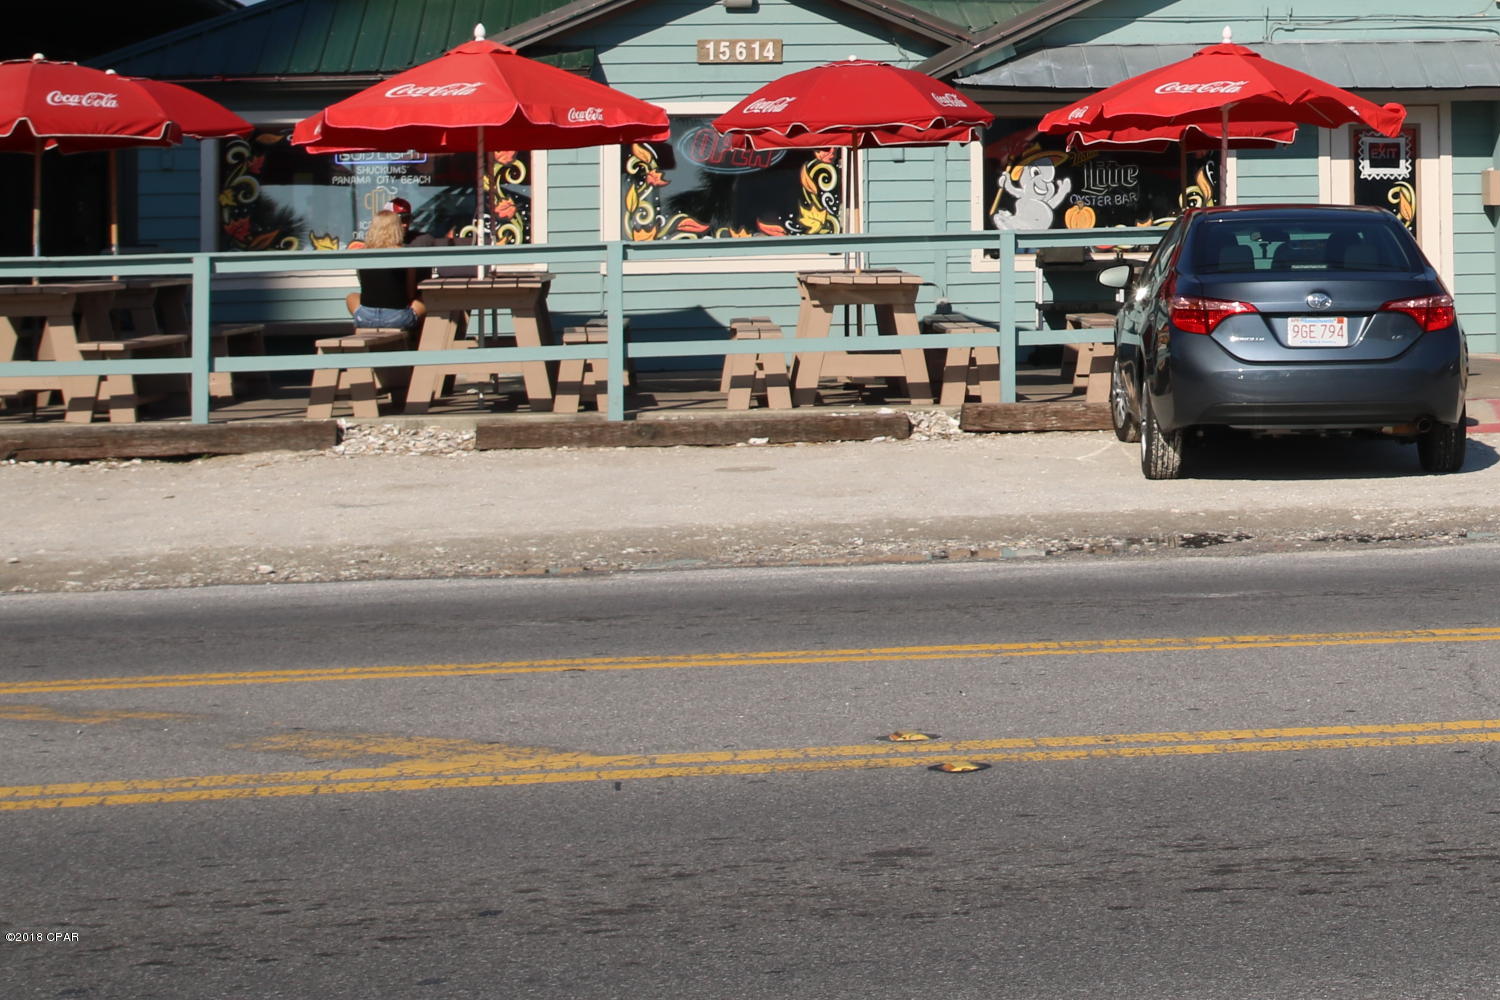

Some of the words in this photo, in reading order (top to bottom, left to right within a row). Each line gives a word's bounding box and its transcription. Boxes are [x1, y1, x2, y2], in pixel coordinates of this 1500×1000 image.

[705, 40, 776, 61] 15614
[384, 81, 486, 98] Coca-Cola
[1155, 80, 1249, 95] Coca-Cola
[46, 89, 119, 108] Coca-Cola
[743, 96, 797, 114] Coca-Cola
[568, 106, 605, 122] Coca-Cola
[332, 176, 371, 185] PANAMA
[376, 175, 397, 185] CITY
[400, 175, 431, 184] BEACH
[1070, 193, 1112, 207] OYSTER
[1114, 192, 1138, 206] BAR
[1292, 324, 1317, 339] 9GE
[1320, 324, 1344, 339] 794
